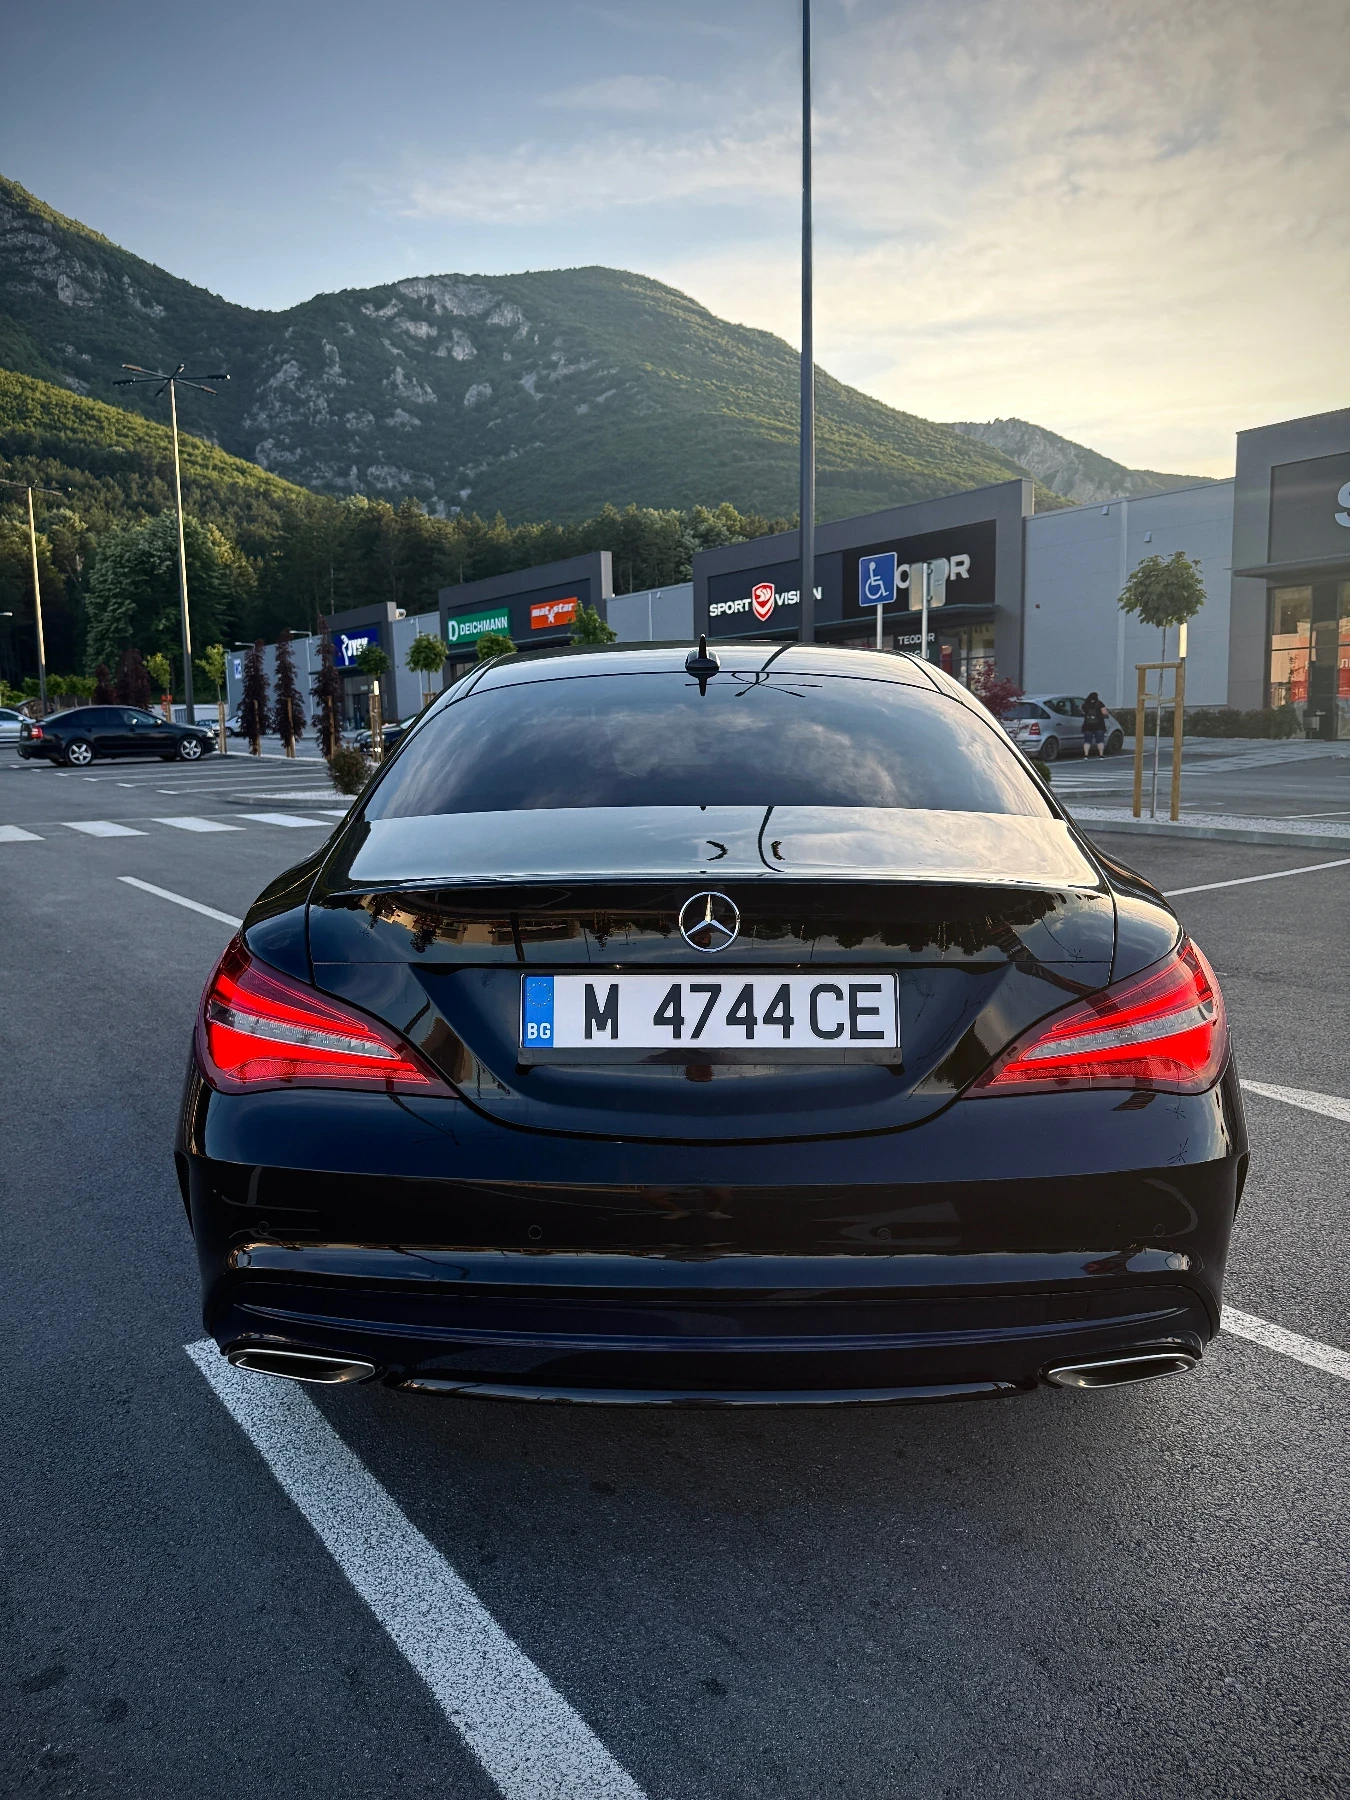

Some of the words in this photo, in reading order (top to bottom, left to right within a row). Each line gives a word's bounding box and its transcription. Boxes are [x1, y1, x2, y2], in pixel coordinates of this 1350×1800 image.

[532, 606, 550, 617] mat
[553, 602, 575, 613] star
[709, 598, 752, 617] SPORT
[775, 586, 822, 606] VISIN
[460, 616, 508, 635] DEICHMANN
[897, 632, 936, 646] TEODR
[584, 983, 619, 1040] M
[653, 983, 795, 1040] 4744
[809, 982, 885, 1040] CE
[527, 1022, 551, 1039] BG
